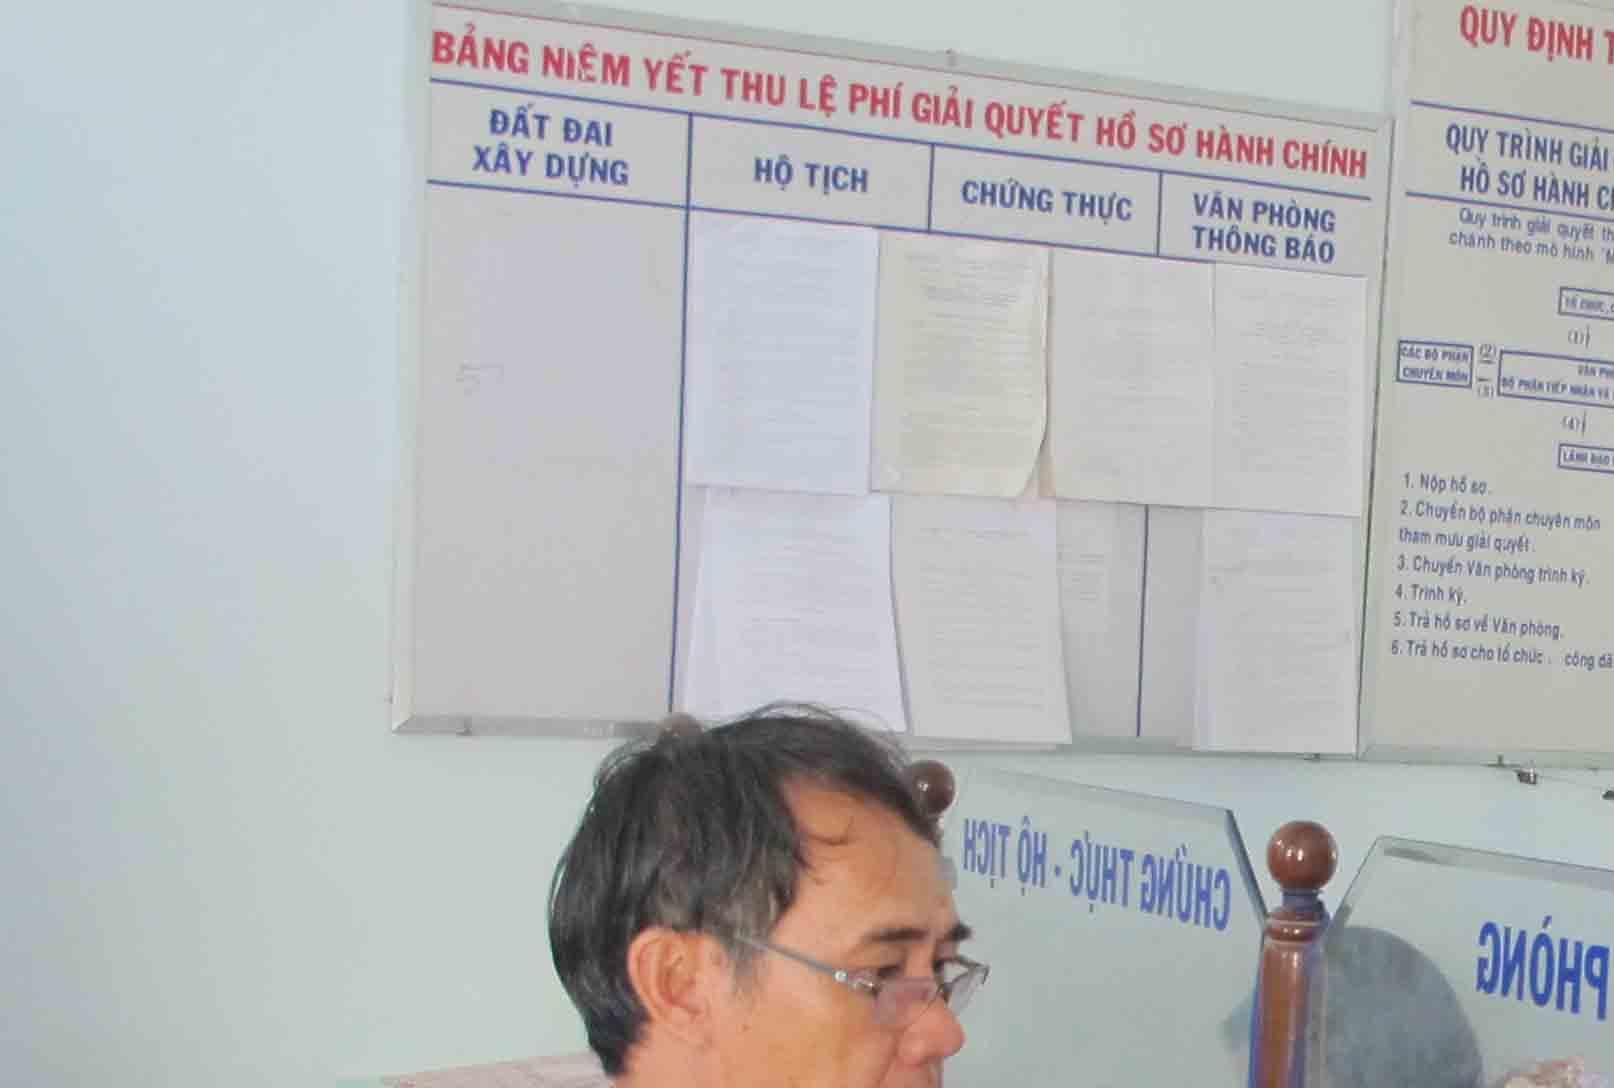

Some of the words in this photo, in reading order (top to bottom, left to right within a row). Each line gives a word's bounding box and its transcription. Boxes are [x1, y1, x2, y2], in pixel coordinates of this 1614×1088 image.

[1460, 4, 1518, 48] QUY
[1527, 16, 1593, 62] ĐỊNH
[432, 23, 528, 74] BẢNG
[643, 50, 708, 96] YẾT
[721, 68, 785, 106] THU
[800, 74, 837, 118] LỆ
[849, 82, 903, 118] PHÍ
[912, 85, 973, 128] GIẢI
[984, 100, 1084, 142] QUYẾT
[1148, 122, 1187, 156] SƠ
[1196, 124, 1273, 166] HÀNH
[1282, 139, 1367, 178] CHÍNH
[489, 103, 550, 141] ĐẤT
[562, 119, 612, 147] ĐAI
[1446, 124, 1488, 156] QUY
[1496, 128, 1563, 165] TRÌNH
[1569, 136, 1608, 172] GIẢI
[472, 142, 533, 176] XÂY
[545, 152, 629, 188] DỰNG
[753, 154, 793, 190] HỘ
[805, 162, 869, 194] TỊCH
[1460, 156, 1490, 194] HỒ
[1497, 168, 1527, 198] SƠ
[1533, 172, 1589, 207] HÀNH
[961, 176, 1053, 213] CHỨNG
[1062, 191, 1132, 224] THỰC
[1252, 199, 1336, 233] PHÒNG
[1459, 207, 1486, 229] Quy
[1193, 225, 1276, 258] THÔNG
[1286, 237, 1335, 263] BÁO
